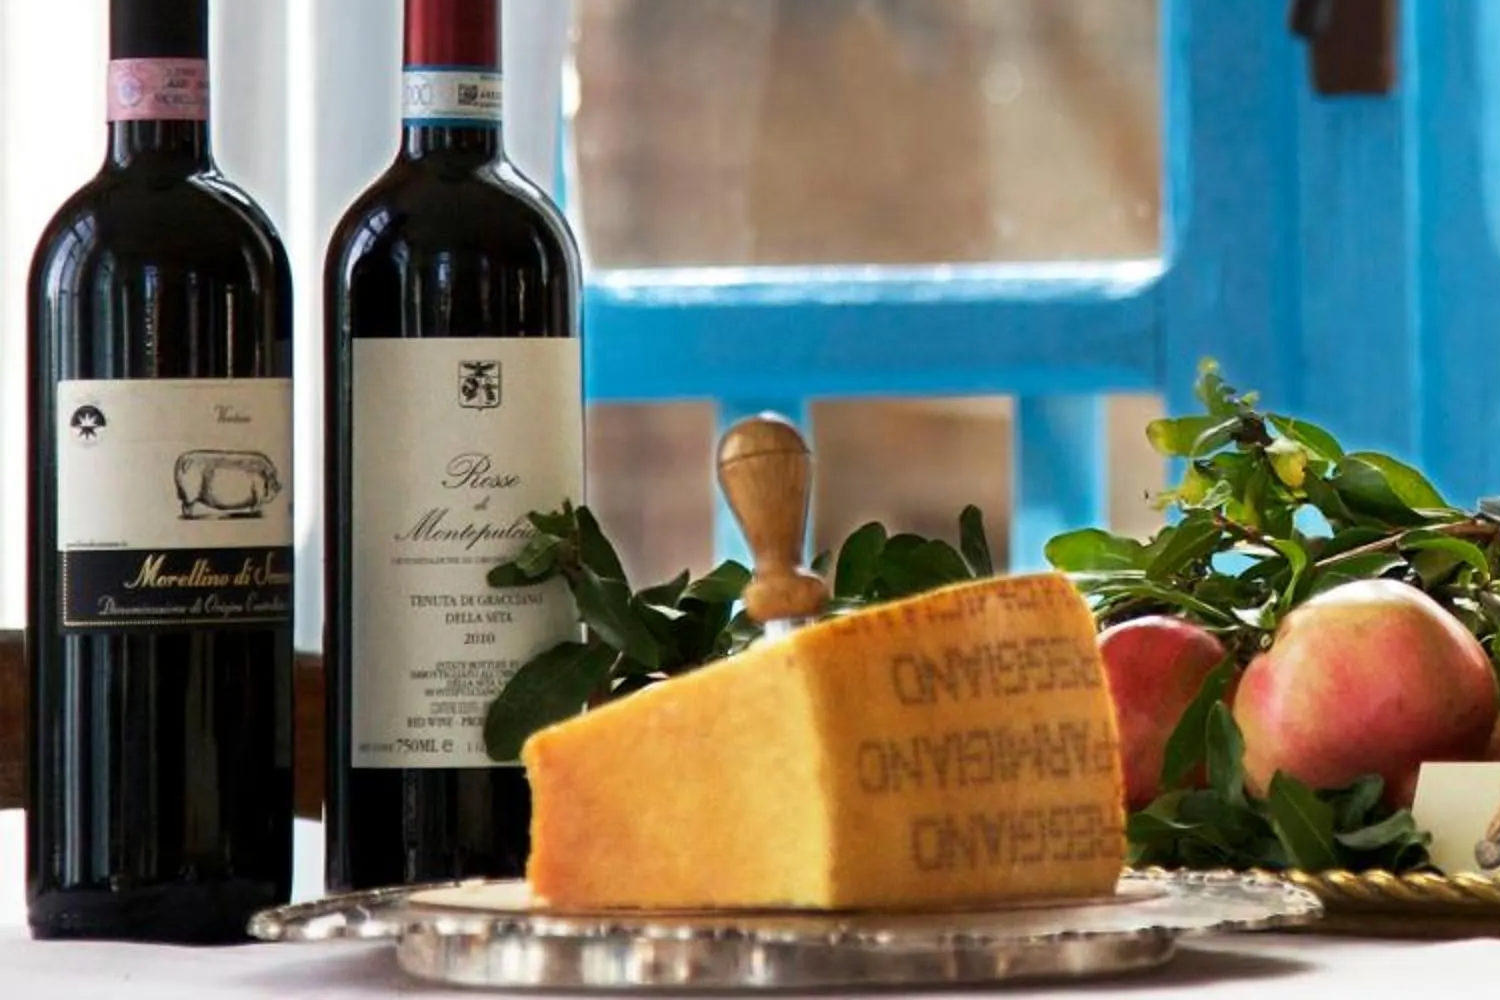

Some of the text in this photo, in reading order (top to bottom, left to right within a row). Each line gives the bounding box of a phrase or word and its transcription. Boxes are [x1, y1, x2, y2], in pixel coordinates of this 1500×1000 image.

[441, 452, 522, 489] Rosso
[123, 553, 229, 588] Morellino
[234, 558, 251, 586] di
[410, 594, 458, 607] TENUTA
[460, 594, 474, 607] DI
[445, 612, 482, 624] DELLA
[463, 632, 496, 645] 2010
